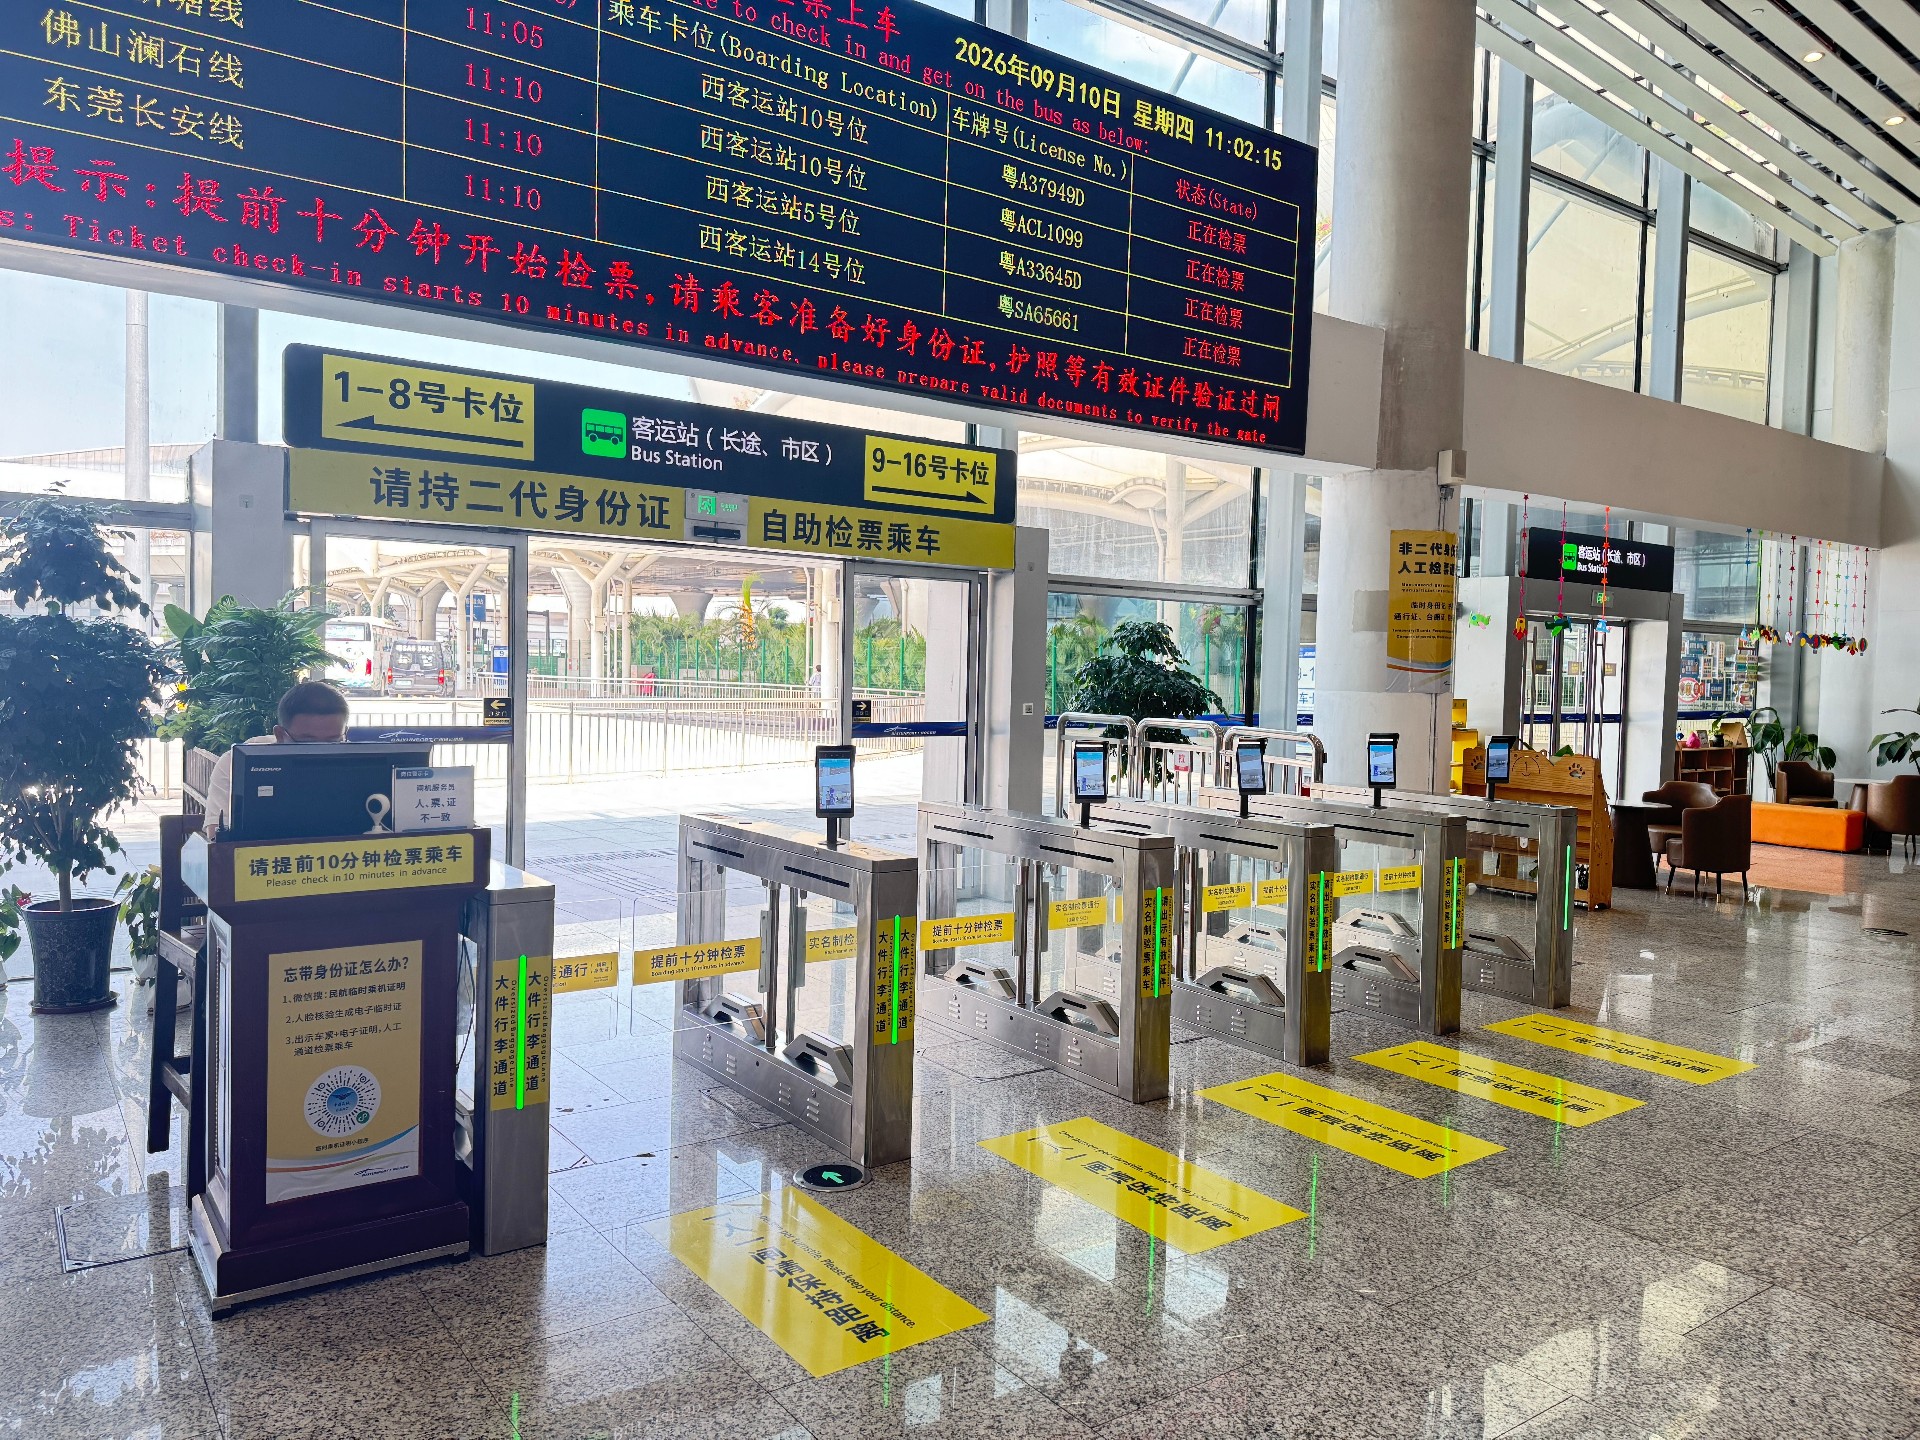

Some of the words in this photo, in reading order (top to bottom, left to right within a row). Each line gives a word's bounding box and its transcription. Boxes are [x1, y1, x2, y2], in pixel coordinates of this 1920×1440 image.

[40, 8, 244, 89] 佛山澜石线
[466, 7, 544, 49] 11:05
[465, 63, 543, 103] 11:10
[771, 12, 831, 48] check
[844, 34, 867, 60] in
[878, 51, 911, 74] and
[922, 66, 953, 89] get
[965, 81, 986, 100] on
[996, 88, 1024, 112] the
[1033, 98, 1063, 125] bus
[1072, 117, 1090, 135] as
[1099, 122, 1150, 153] below:
[841, 71, 938, 122] Location)
[43, 76, 244, 150] 东莞长安线
[701, 73, 869, 144] 西客运站10号位
[954, 37, 1121, 119] 2026年09月10日
[1133, 100, 1195, 144] 星期四
[1205, 127, 1283, 171] 11:02:15
[465, 118, 543, 157] 11:10
[700, 123, 868, 191] 西客运站10号位
[1001, 163, 1085, 208] 粤A37949D
[1093, 154, 1128, 181] No.)
[464, 174, 542, 211] 11:10
[705, 174, 861, 236] 西客运站5号位
[1175, 179, 1258, 221] 状态(State)
[999, 207, 1083, 249] 粤ACL1099
[1187, 219, 1247, 255] 正在检票
[699, 223, 866, 285] 西客运站14号位
[998, 250, 1082, 290] 粤A33645D
[1186, 258, 1245, 292] 正在检票
[63, 214, 188, 257] Ticket
[213, 243, 362, 287] check-in
[383, 275, 483, 307] starts
[501, 292, 531, 315] 10
[546, 303, 649, 337] minutes
[665, 322, 690, 343] in
[704, 332, 800, 365] advance,
[817, 352, 886, 379] please
[897, 370, 970, 395] prepare
[981, 383, 1028, 405] valid
[1037, 392, 1118, 420] documents
[1126, 408, 1143, 424] to
[1151, 413, 1199, 433] verify
[1207, 422, 1230, 438] the
[1236, 429, 1267, 445] gate
[997, 293, 1080, 332] 粤SA65661
[1184, 297, 1243, 329] 正在检票
[1183, 337, 1242, 368] 正在检票
[630, 444, 661, 465] Bus
[665, 450, 724, 472] Station
[871, 446, 991, 487] 9-16号卡位
[369, 465, 672, 531] 请持二代身份证
[762, 508, 942, 556] 自助检票乘车
[1577, 561, 1588, 572] Bus
[1587, 562, 1608, 574] Station
[414, 797, 457, 809] 人、票、证
[419, 812, 451, 823] 不一致
[248, 844, 464, 878] 请提前10分钟检票乘车
[266, 877, 297, 888] Please
[301, 874, 329, 885] check
[332, 873, 342, 882] in
[344, 872, 355, 881] 10
[359, 869, 395, 881] minutes
[399, 867, 408, 877] in
[411, 866, 447, 876] advance
[932, 918, 1003, 937] 提前十分钟检票
[283, 956, 409, 983] 忘带身份证怎么办?
[650, 944, 746, 970] 提前十分钟检票
[875, 930, 889, 1033] 大件行李通道
[899, 929, 910, 1030] 大件行李通道
[293, 1041, 354, 1057] 通道检票乘车
[493, 974, 510, 1097] 大件行李通道
[525, 971, 542, 1091] 大件行李通道
[702, 1211, 890, 1344] 一人一闸请保持距离
[819, 1258, 849, 1276] Please
[839, 1274, 868, 1290] keep
[855, 1287, 884, 1303] your
[877, 1301, 921, 1329] distance.
